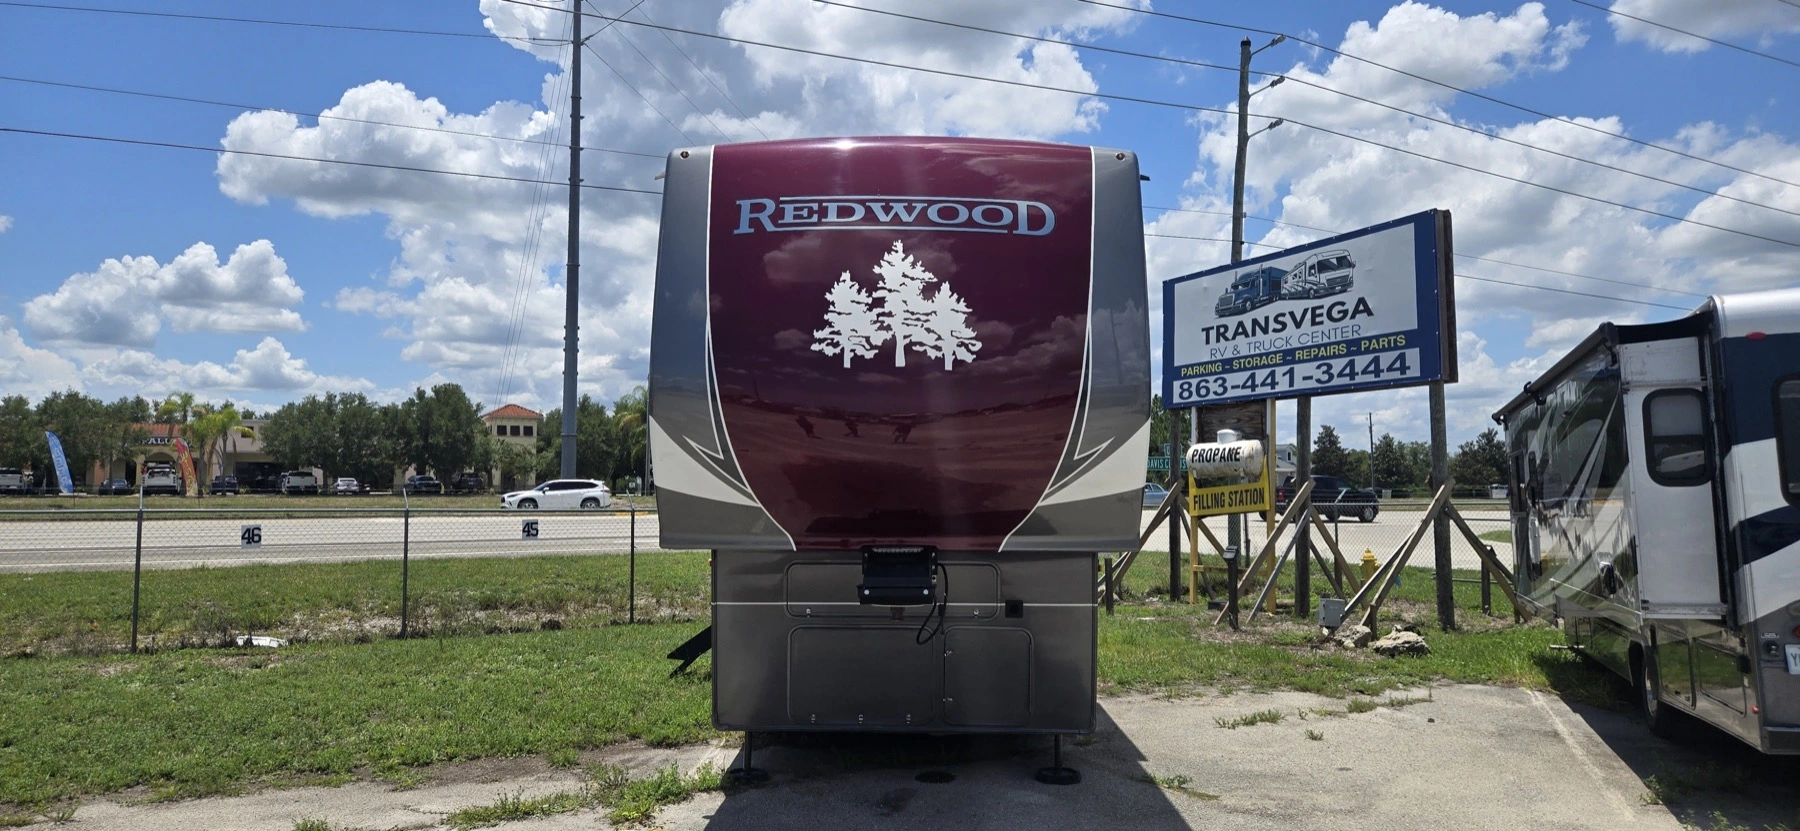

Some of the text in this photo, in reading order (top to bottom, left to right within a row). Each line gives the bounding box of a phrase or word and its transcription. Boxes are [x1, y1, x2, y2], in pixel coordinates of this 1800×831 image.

[733, 196, 1056, 236] REDWOOD
[1201, 296, 1374, 345] TRANSVEGA
[1181, 363, 1222, 377] PARKING
[1233, 353, 1283, 369] STORAGE
[1295, 343, 1347, 361] REPAIRS
[1361, 335, 1406, 352] PARTS
[1210, 324, 1361, 359] RV & TRUCK CENTER
[1178, 351, 1411, 401] 863-441-3444
[1192, 446, 1242, 463] PROPANE
[1193, 487, 1264, 511] FILLING STATION
[241, 527, 261, 544] 46
[522, 521, 539, 537] 45
